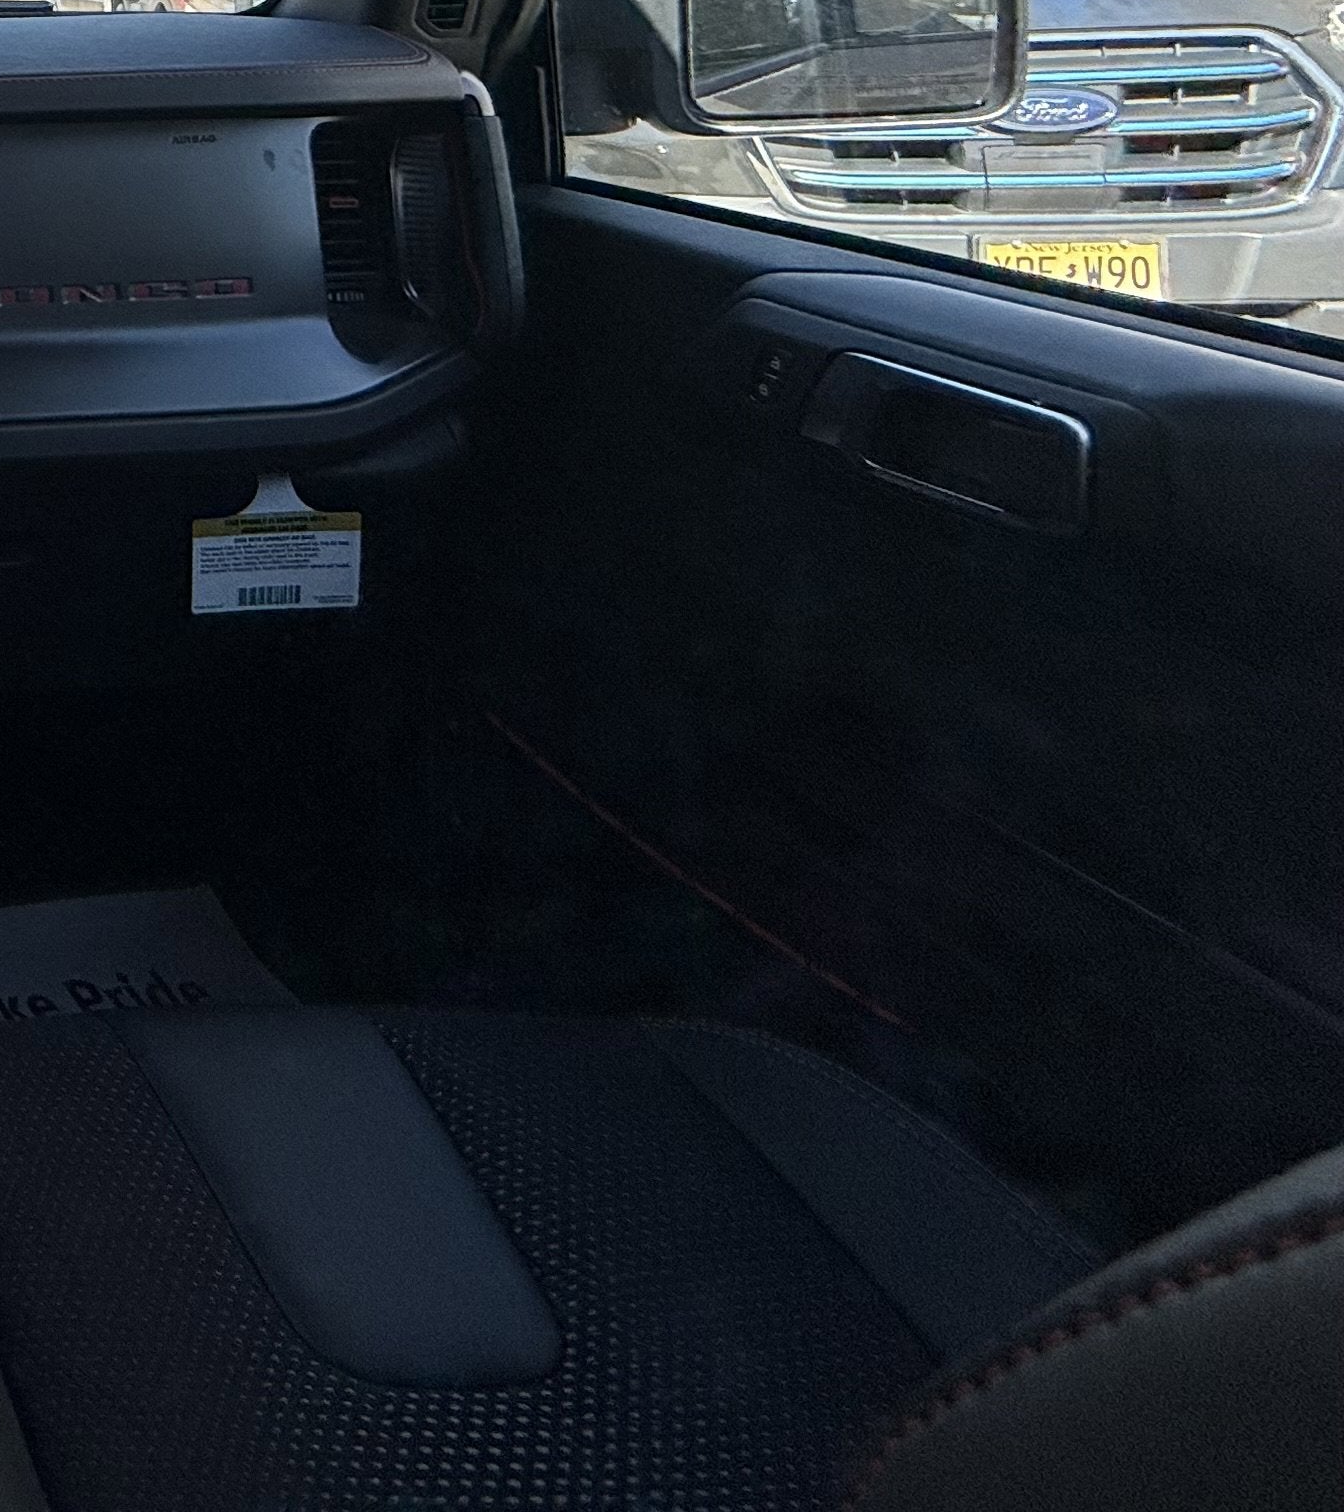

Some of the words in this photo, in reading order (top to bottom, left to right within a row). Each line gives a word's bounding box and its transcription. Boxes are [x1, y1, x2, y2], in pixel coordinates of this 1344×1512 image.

[172, 134, 216, 144] AIRBAG
[1065, 242, 1114, 254] Jersey
[1084, 256, 1151, 289] W90
[63, 969, 211, 1013] Pride
